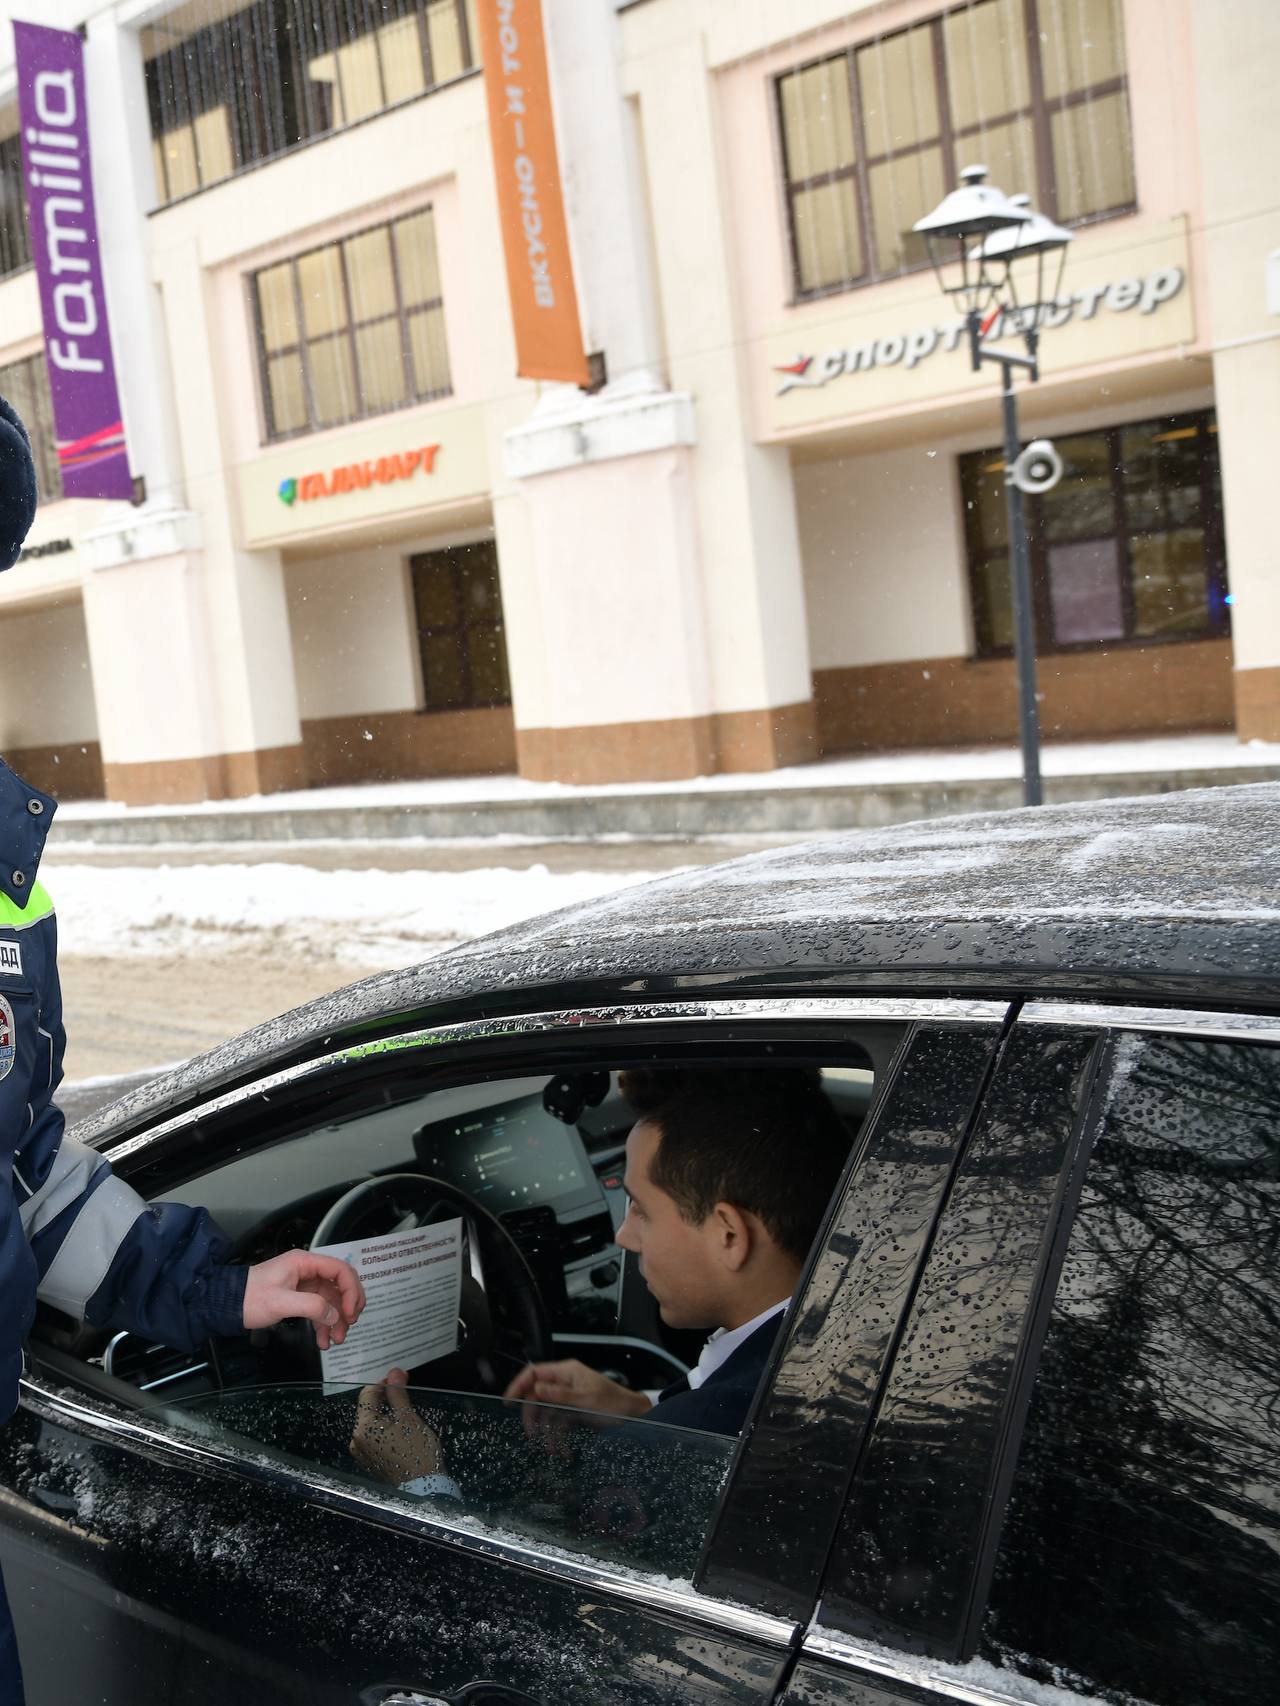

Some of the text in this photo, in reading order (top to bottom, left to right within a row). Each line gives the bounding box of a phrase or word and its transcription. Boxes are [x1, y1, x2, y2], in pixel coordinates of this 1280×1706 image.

[26, 69, 105, 373] familia
[514, 155, 556, 308] ВКУСНО
[360, 1268, 392, 1282] ЕРЕВОЗКИ
[362, 1250, 397, 1266] БОЛЬШАЯ
